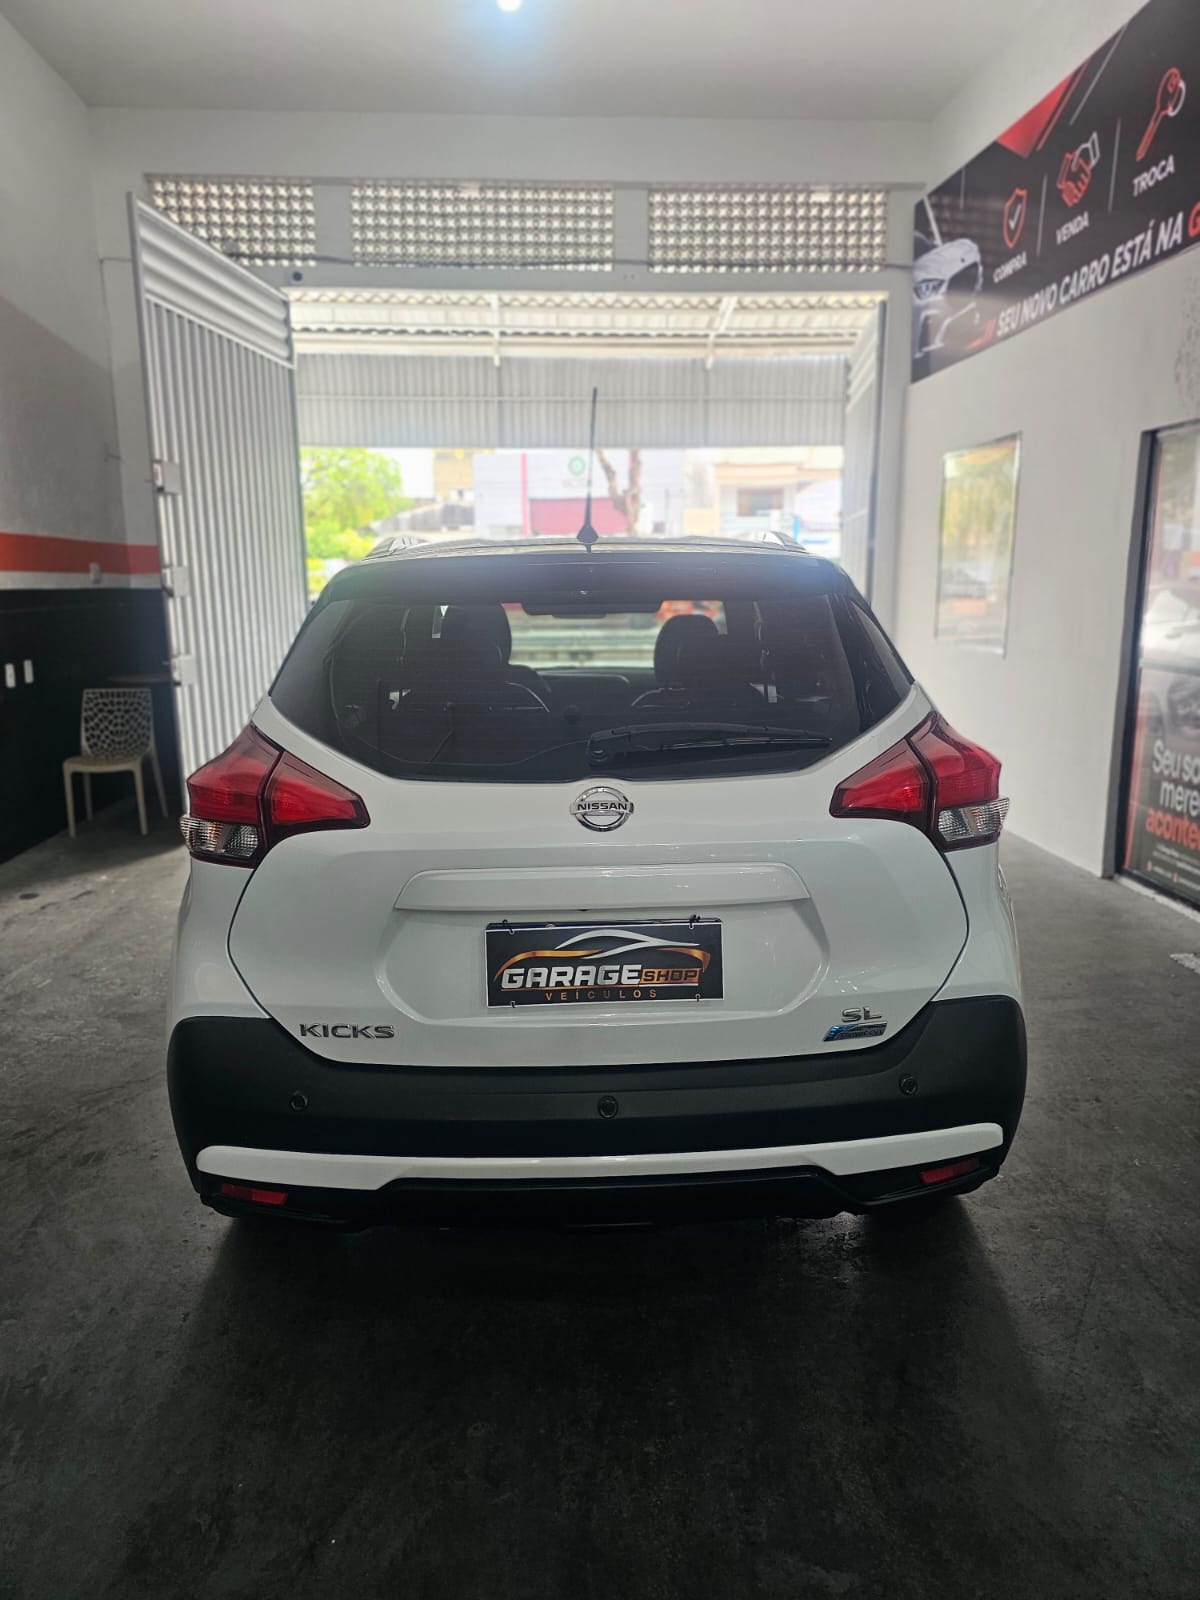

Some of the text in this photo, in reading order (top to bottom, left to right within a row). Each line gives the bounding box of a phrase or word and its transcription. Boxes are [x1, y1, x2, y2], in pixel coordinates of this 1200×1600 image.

[1132, 154, 1175, 197] TROCA
[1056, 211, 1090, 245] VENDA
[996, 301, 1021, 337] SEU
[1020, 282, 1058, 324] NOVO
[1058, 253, 1111, 304] CARRO
[1110, 219, 1153, 279] ESTÁ
[1154, 211, 1184, 256] NA
[1152, 740, 1181, 779] Seu
[577, 802, 628, 811] NISSAN
[1146, 808, 1200, 849] aconte
[501, 964, 700, 989] GARAGE SHOP
[299, 1023, 395, 1039] KICKS
[841, 1006, 883, 1023] SL
